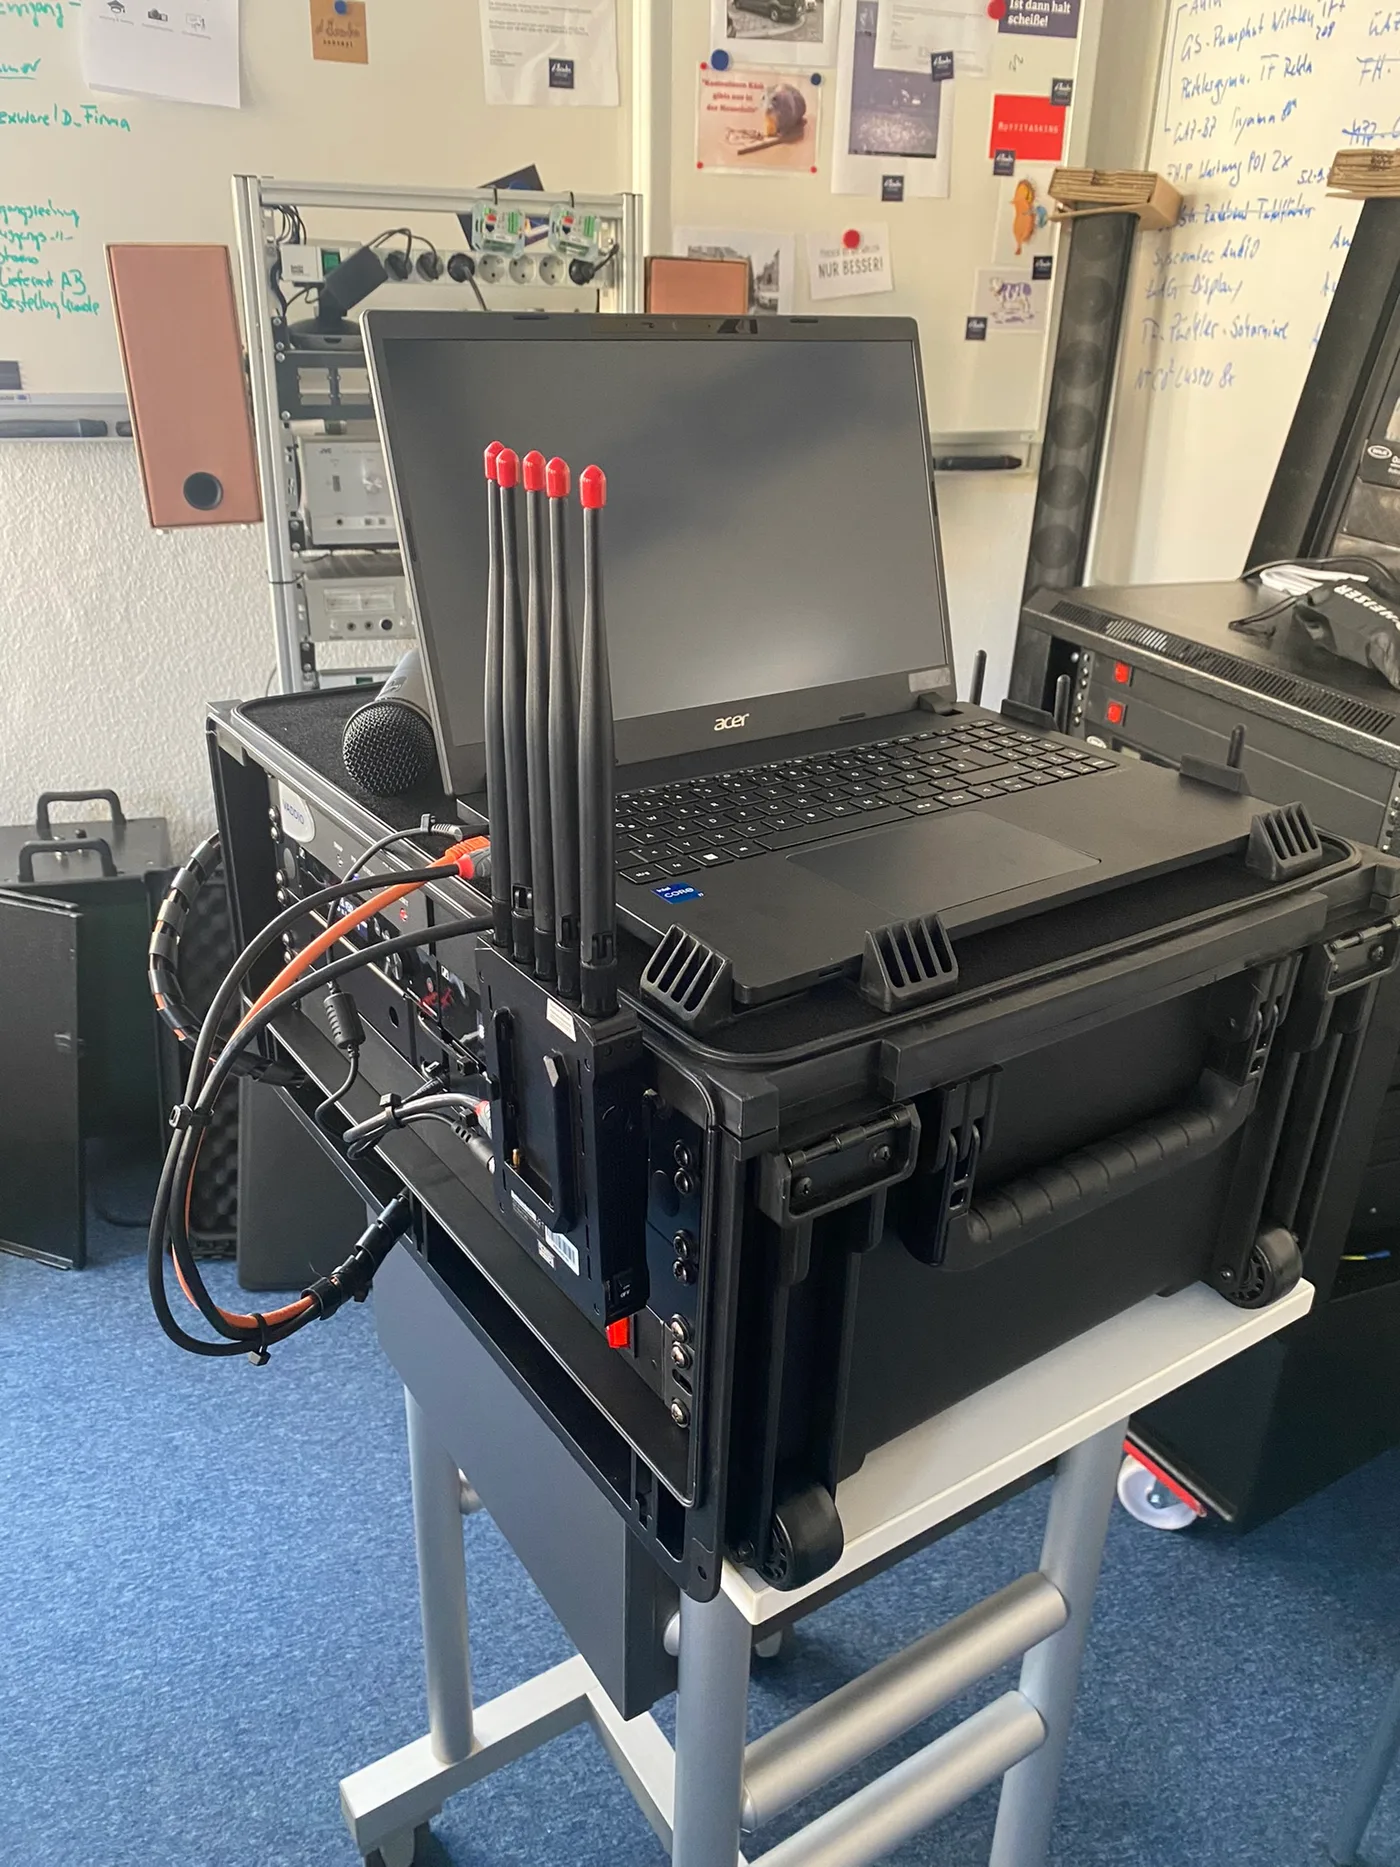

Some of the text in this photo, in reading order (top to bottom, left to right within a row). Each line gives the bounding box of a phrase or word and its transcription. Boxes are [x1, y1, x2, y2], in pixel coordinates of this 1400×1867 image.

[1025, 0, 1050, 12] dann
[1051, 0, 1071, 14] halt
[1007, 13, 1049, 27] scheiße!
[818, 256, 883, 279] NUR BESSER!
[713, 713, 750, 731] acer
